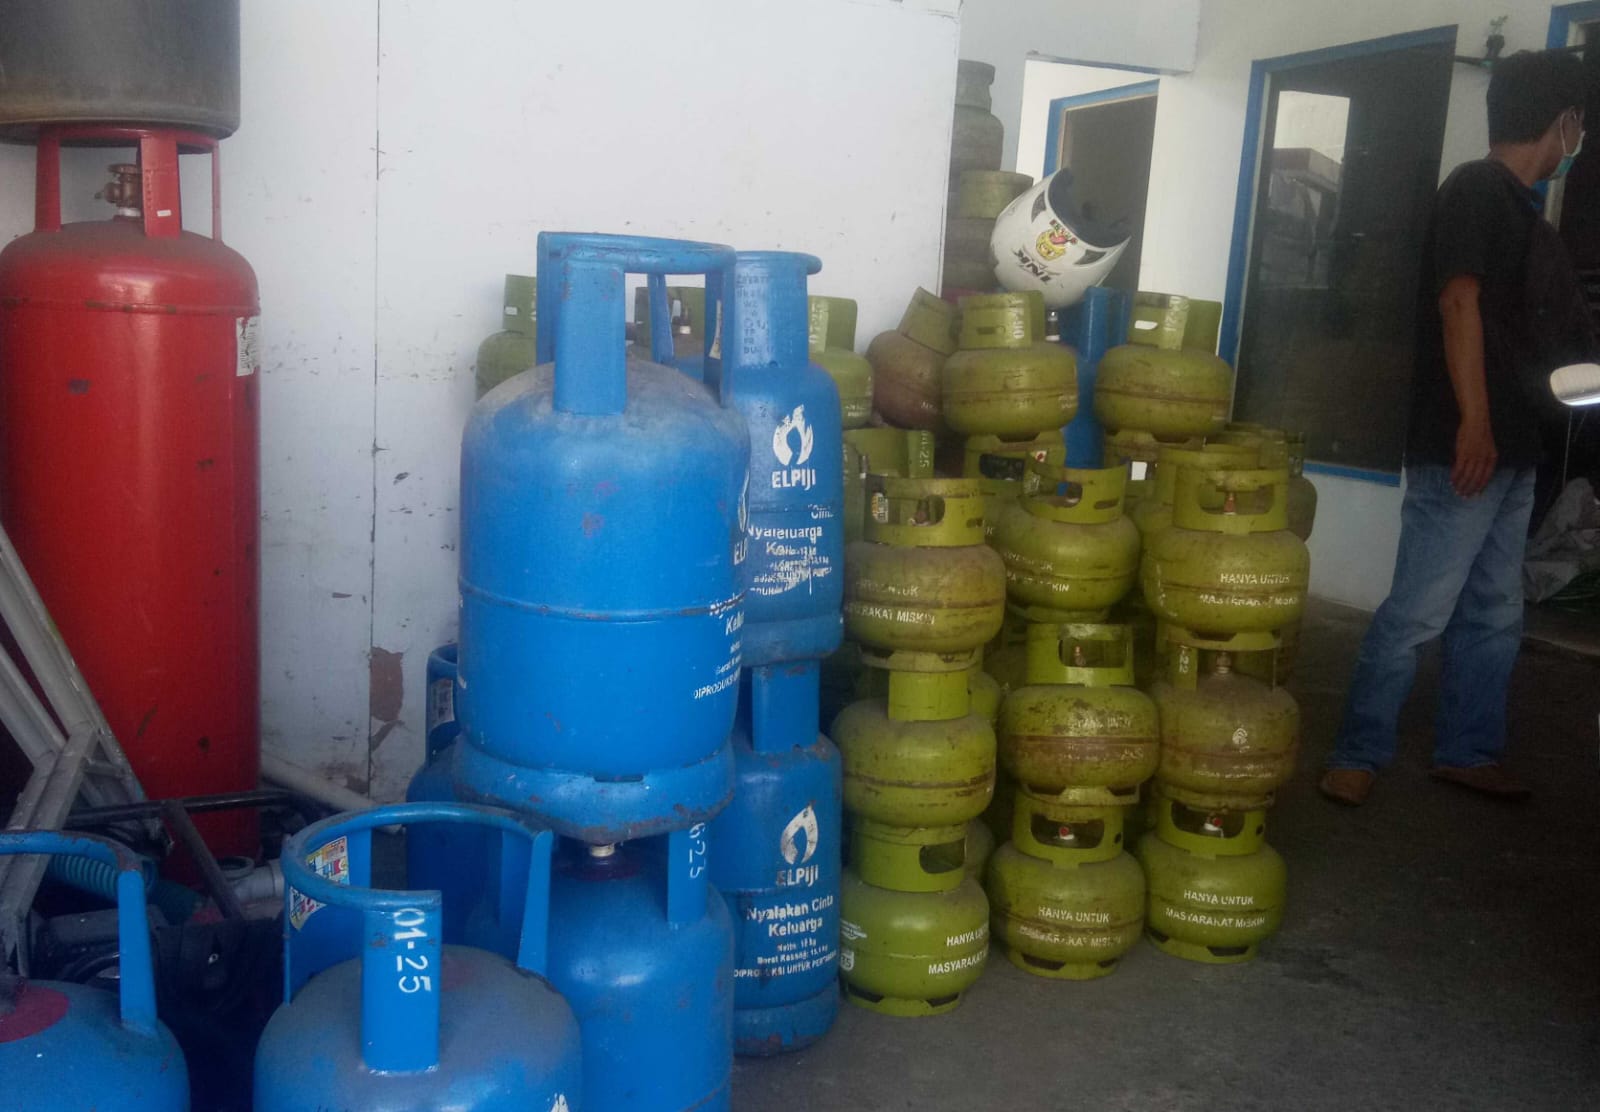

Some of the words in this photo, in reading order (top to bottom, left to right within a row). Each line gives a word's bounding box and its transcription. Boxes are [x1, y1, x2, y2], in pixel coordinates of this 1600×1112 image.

[772, 468, 816, 490] ELPIJI
[1220, 572, 1258, 585] HANYA
[1183, 889, 1219, 905] HANYA
[1220, 895, 1254, 906] UNTUK
[746, 901, 809, 923] Nyalakan
[1038, 906, 1073, 921] HANYA
[1075, 911, 1110, 924] UNTUK
[768, 916, 824, 937] Keluarga
[946, 931, 975, 948] HANYA
[393, 907, 432, 993] 01-25
